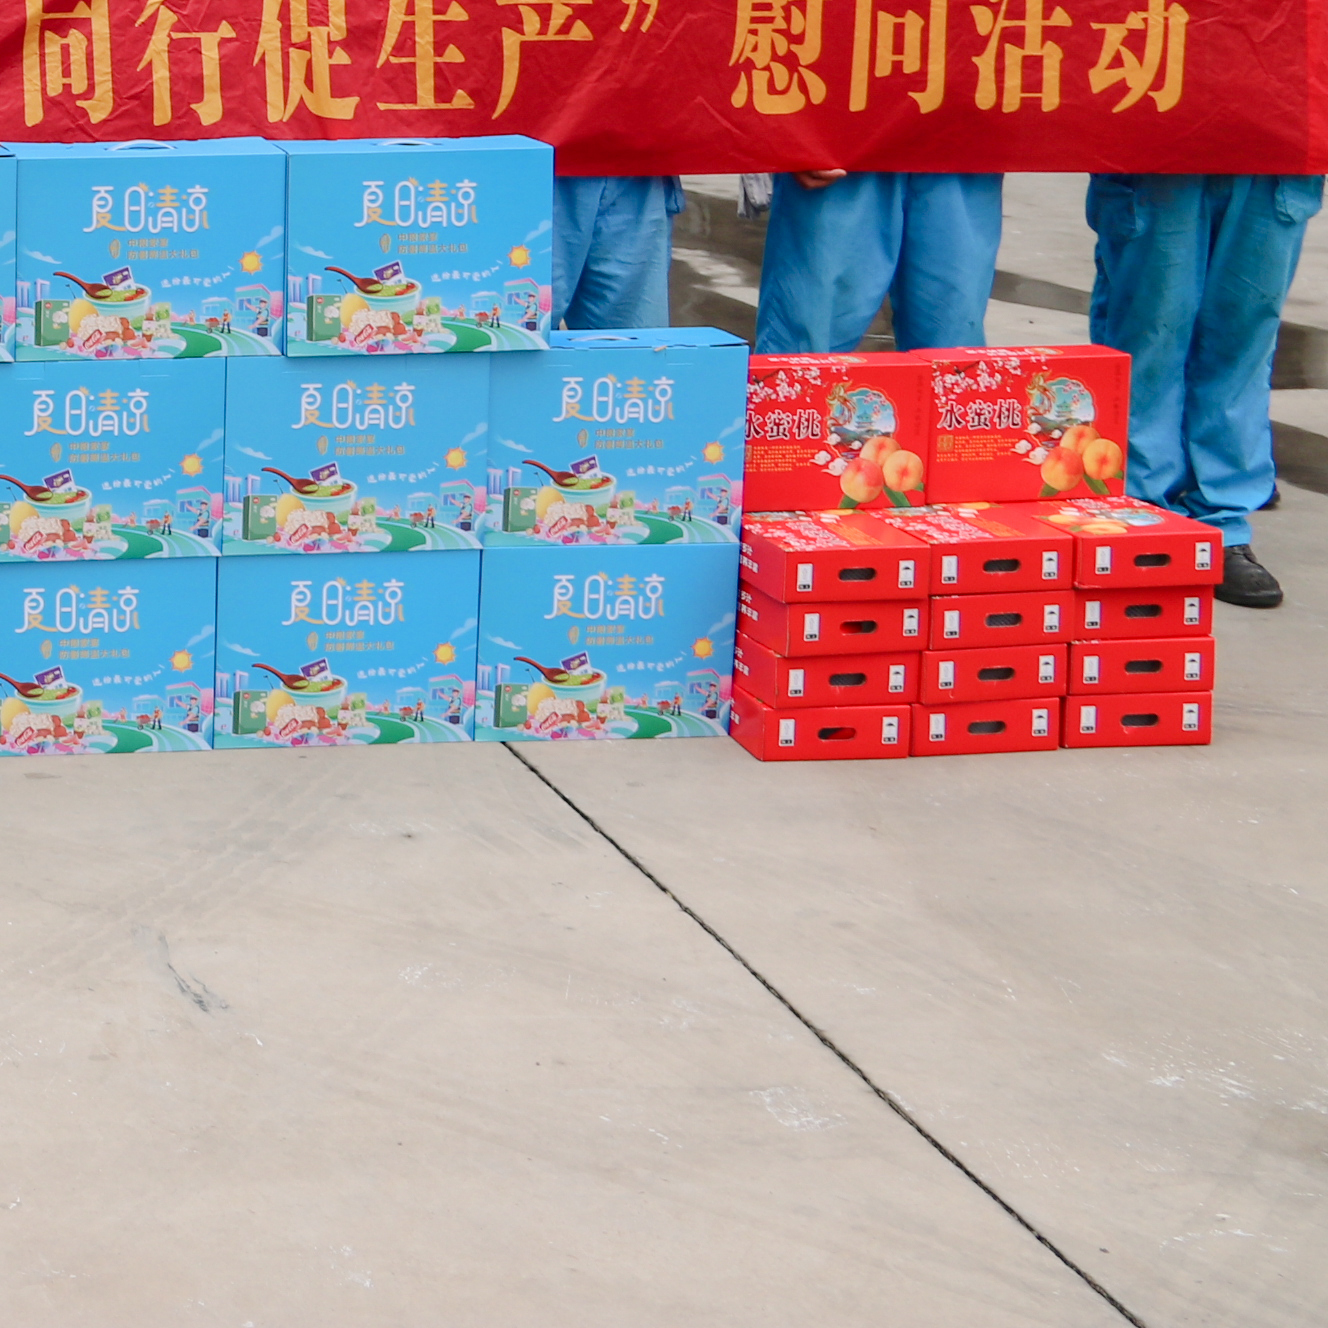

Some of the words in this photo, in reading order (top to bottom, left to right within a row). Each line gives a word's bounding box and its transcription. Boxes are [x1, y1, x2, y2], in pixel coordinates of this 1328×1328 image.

[83, 181, 211, 235] 夏日清凉
[353, 176, 479, 229] 夏日清凉
[23, 385, 151, 438] 夏日清凉
[291, 379, 417, 431] 夏日清凉
[553, 373, 676, 425] 夏日清凉
[936, 398, 1023, 431] 水蜜桃
[14, 583, 141, 635] 夏日清凉
[282, 576, 406, 628] 夏日清凉
[544, 571, 666, 622] 夏日清凉
